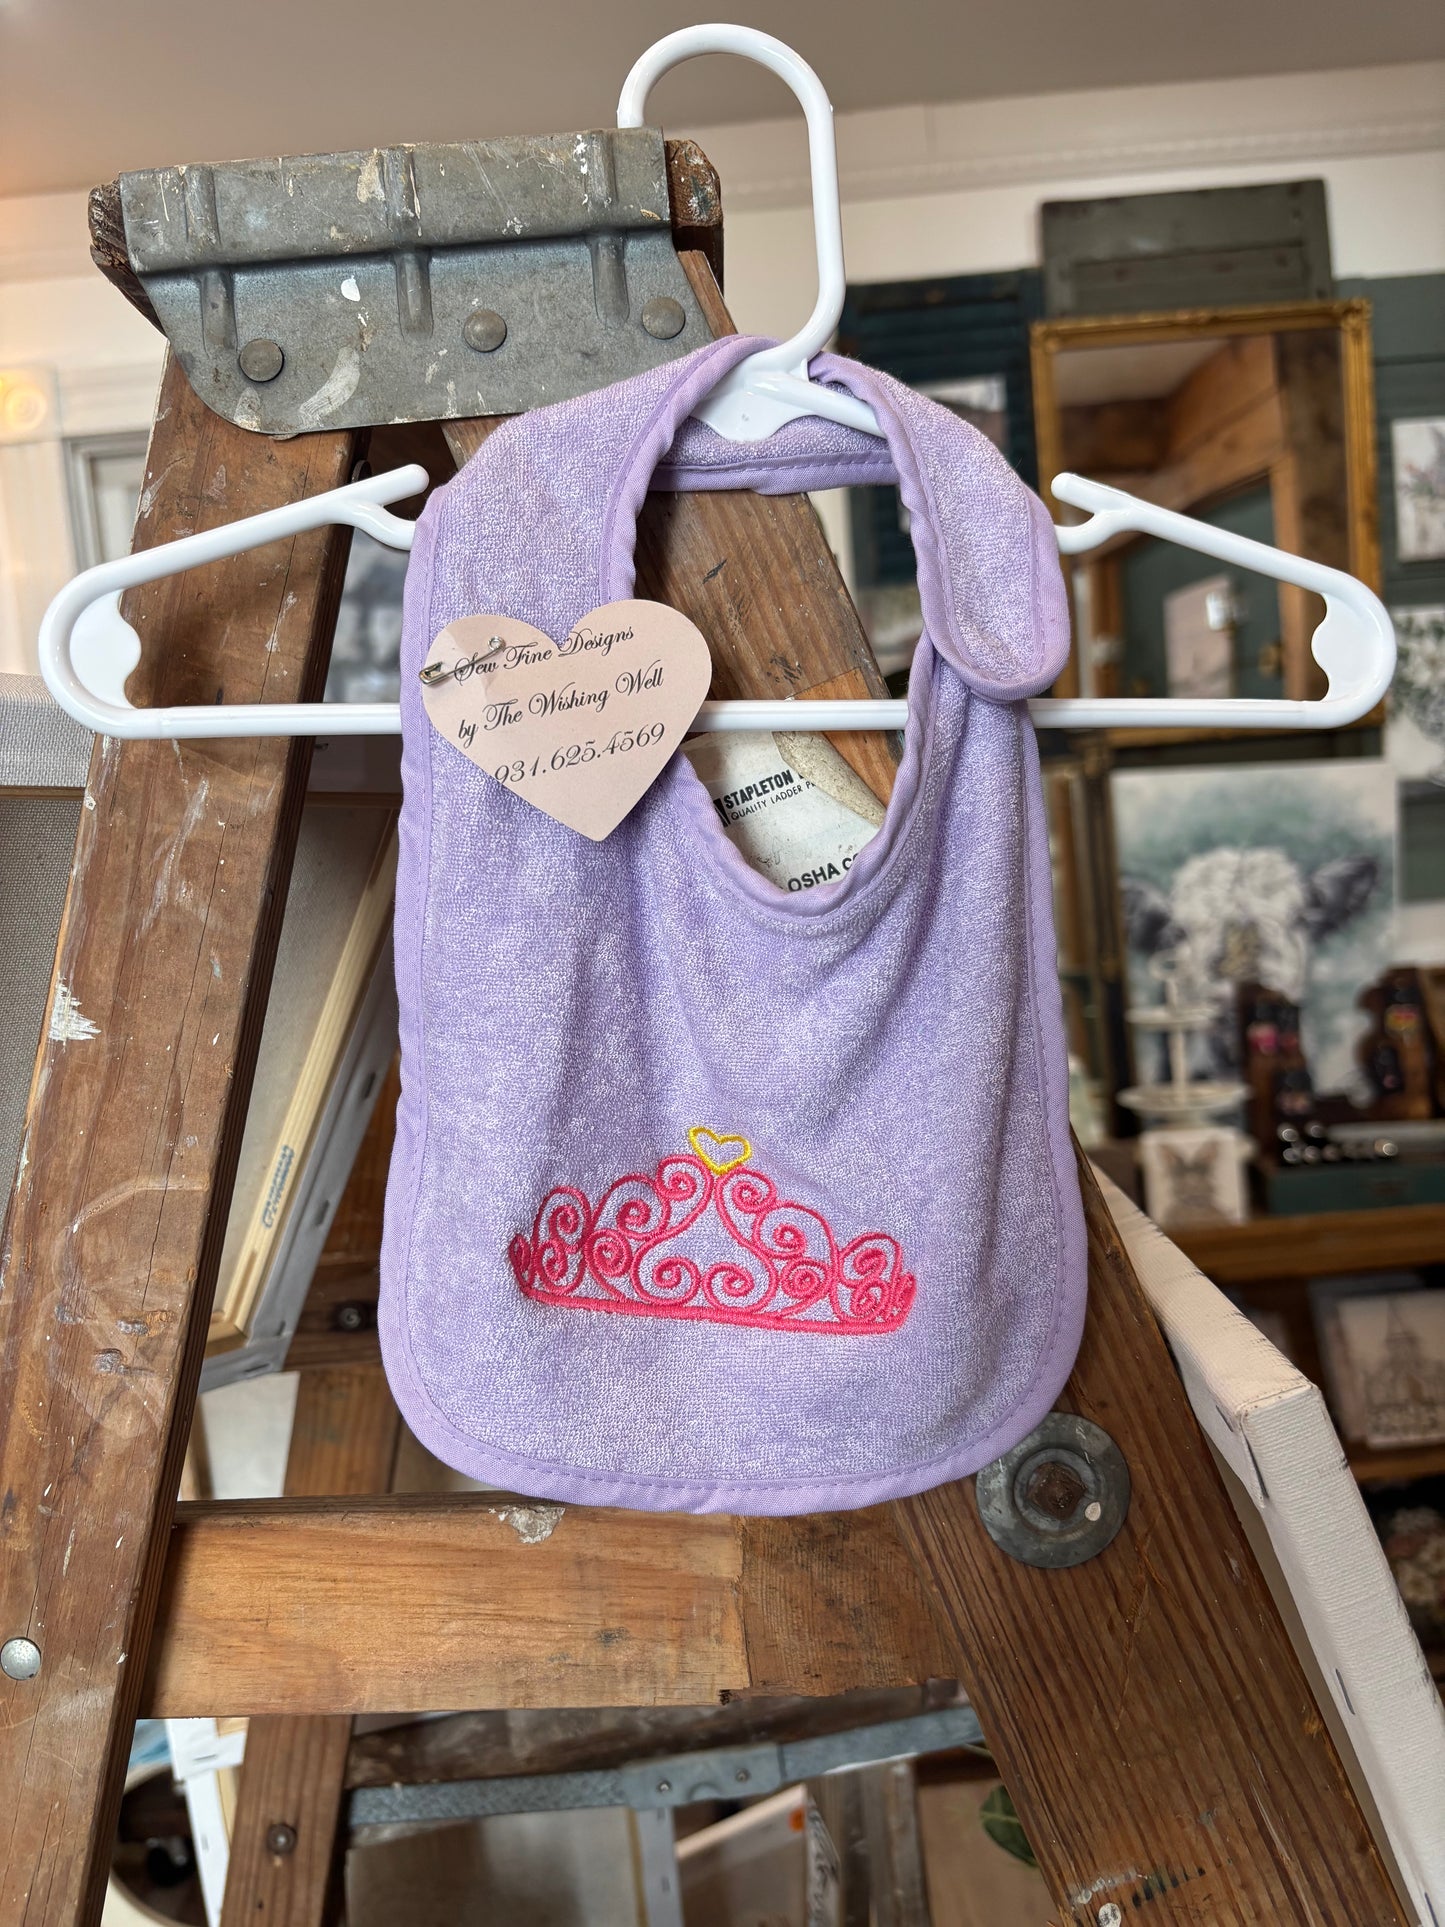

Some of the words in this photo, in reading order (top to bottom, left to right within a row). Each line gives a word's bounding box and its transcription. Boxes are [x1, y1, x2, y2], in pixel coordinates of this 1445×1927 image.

[454, 651, 498, 686] Sew
[503, 641, 552, 670] Fine
[558, 625, 634, 659] Designs
[458, 719, 479, 749] by
[482, 698, 522, 730] The
[528, 681, 610, 717] Wishing
[615, 659, 664, 697] Well
[494, 722, 665, 788] 931.625.4569
[724, 769, 794, 809] STAPLETON
[730, 800, 767, 820] QUALITY
[770, 785, 804, 804] LADDER
[788, 862, 841, 892] OSHA
